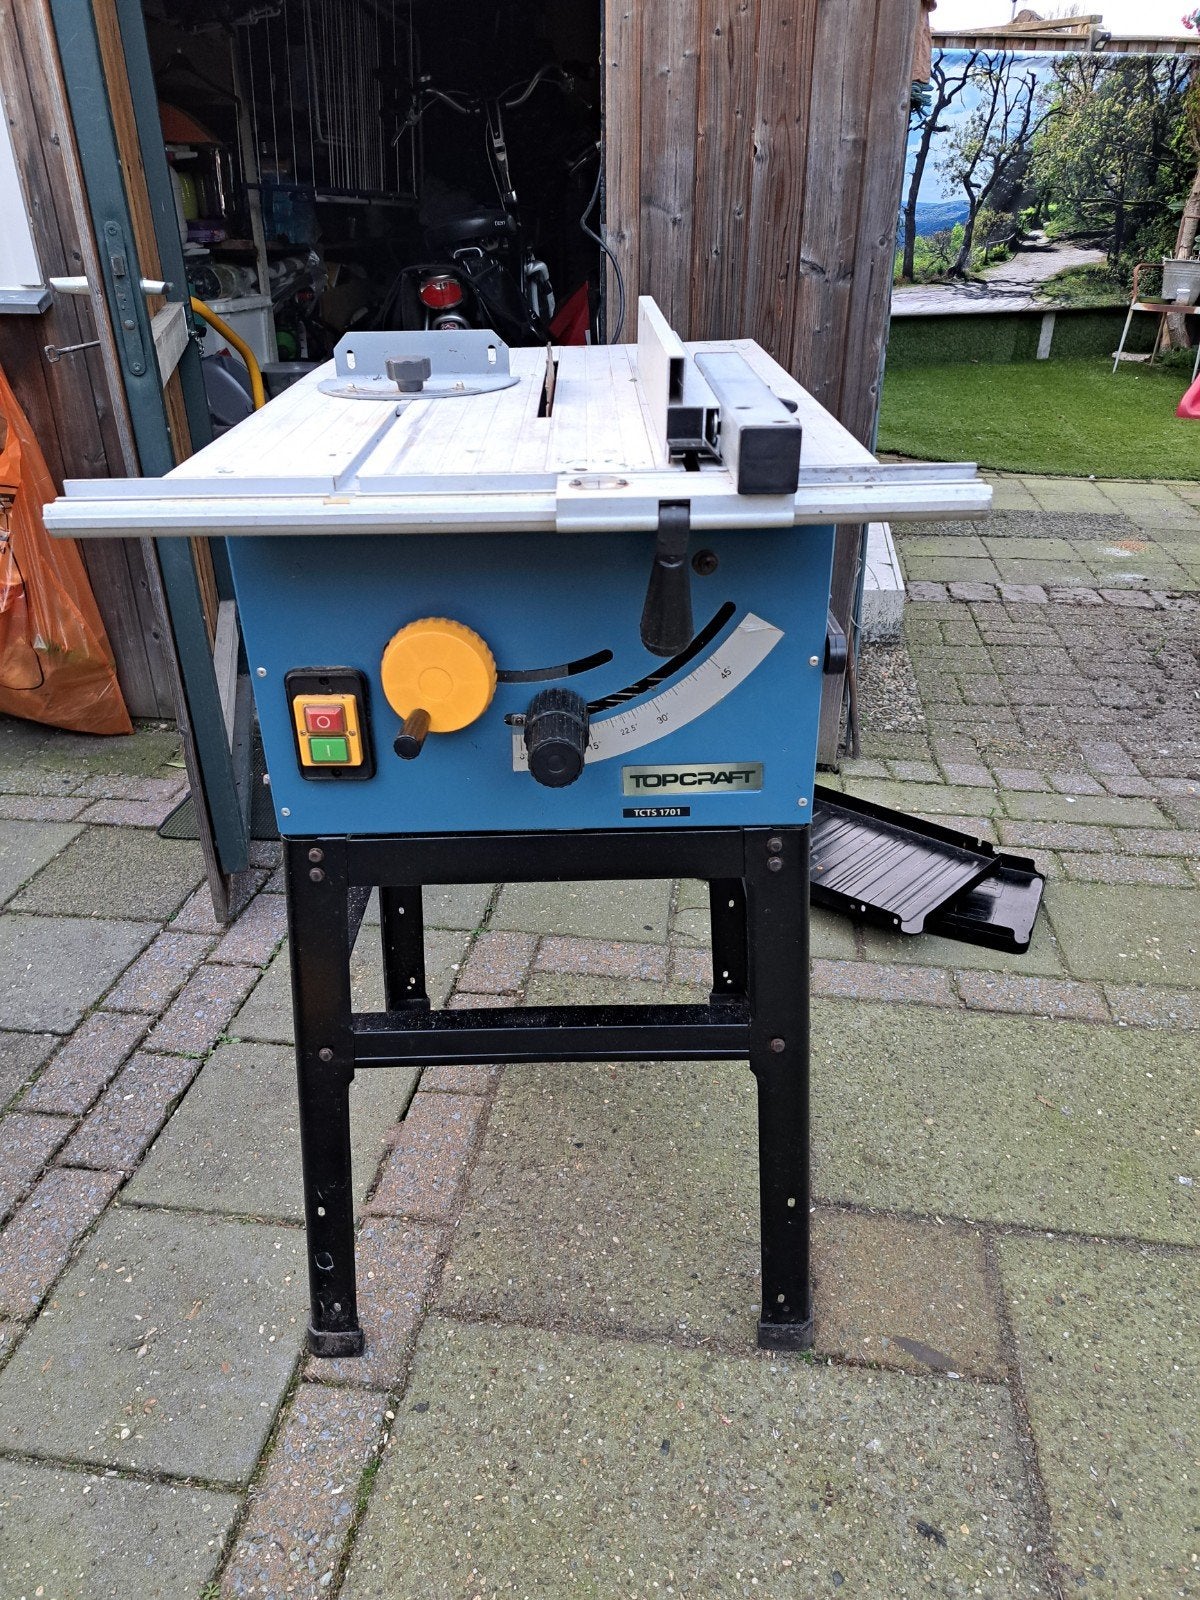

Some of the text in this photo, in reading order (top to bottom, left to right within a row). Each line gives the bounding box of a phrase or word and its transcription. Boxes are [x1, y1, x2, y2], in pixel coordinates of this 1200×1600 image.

[629, 770, 756, 788] TOPCRAFT
[633, 808, 681, 817] TCTS 1701
